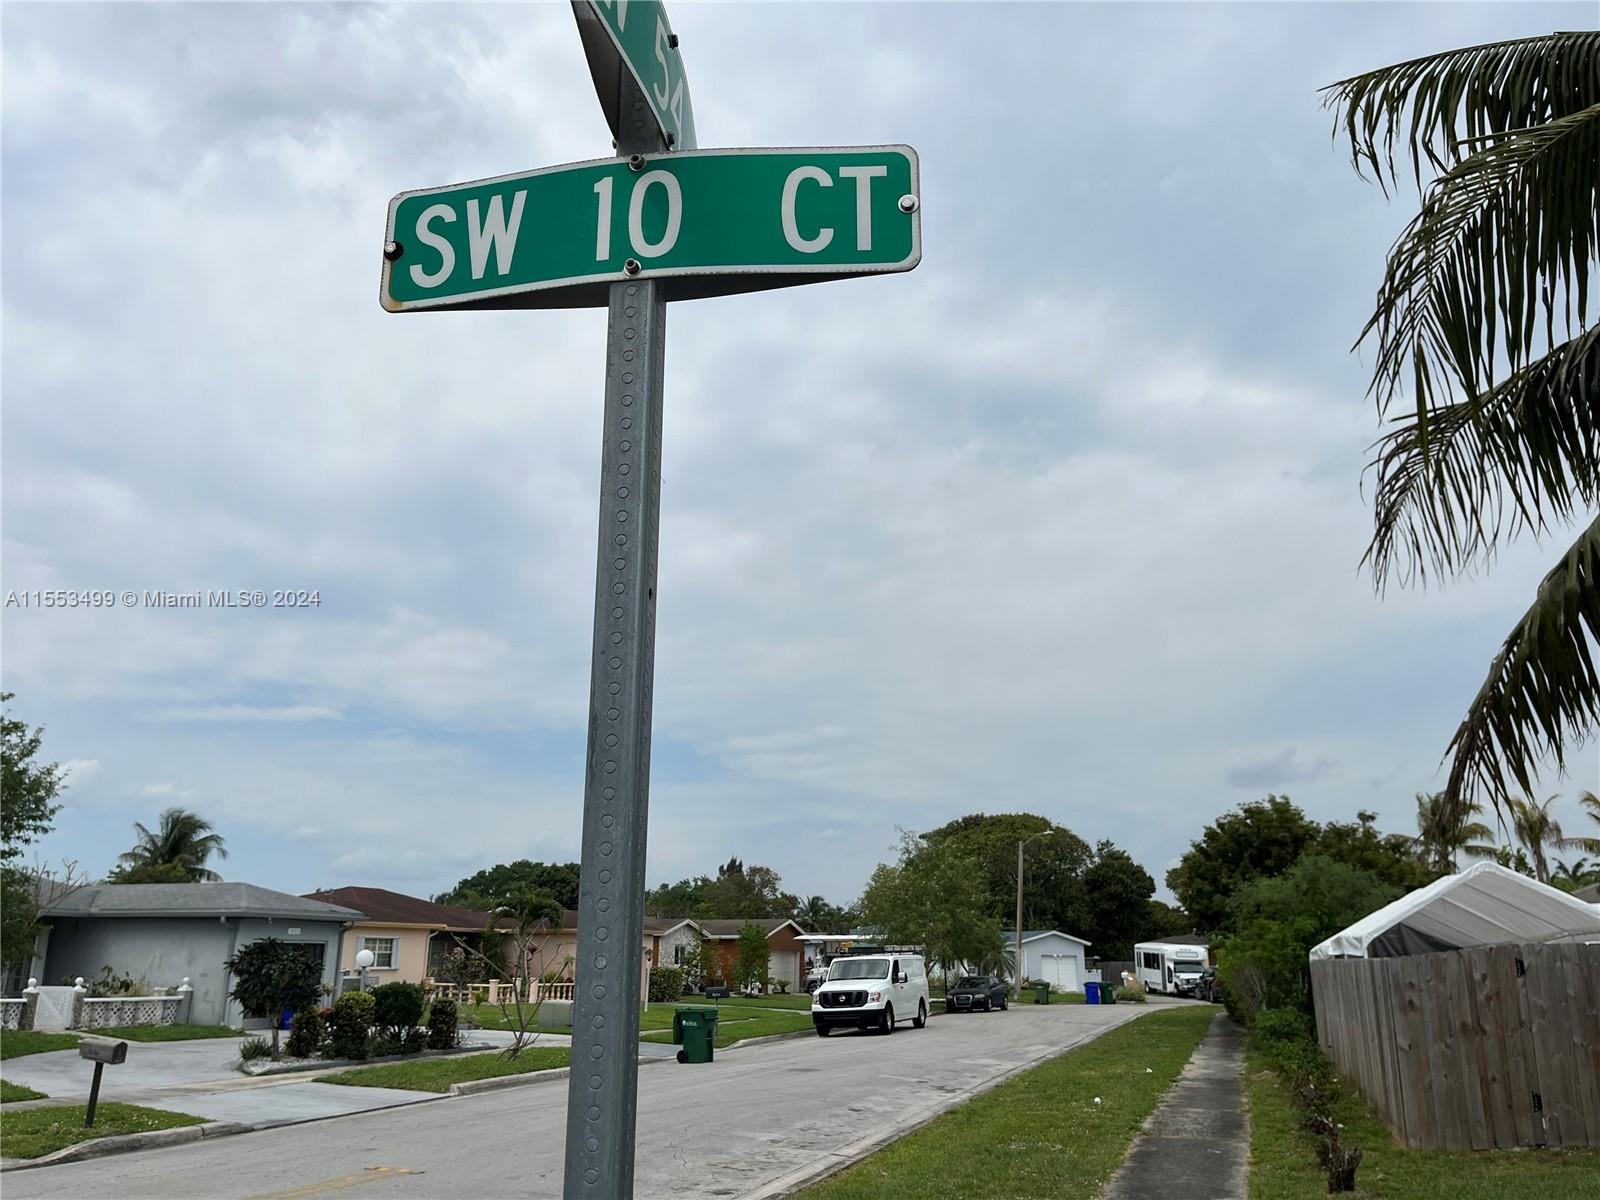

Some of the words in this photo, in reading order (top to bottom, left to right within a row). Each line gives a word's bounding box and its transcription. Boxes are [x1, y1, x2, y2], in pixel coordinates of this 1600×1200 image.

[409, 189, 528, 289] SW
[593, 169, 683, 262] 10
[780, 165, 888, 254] CT
